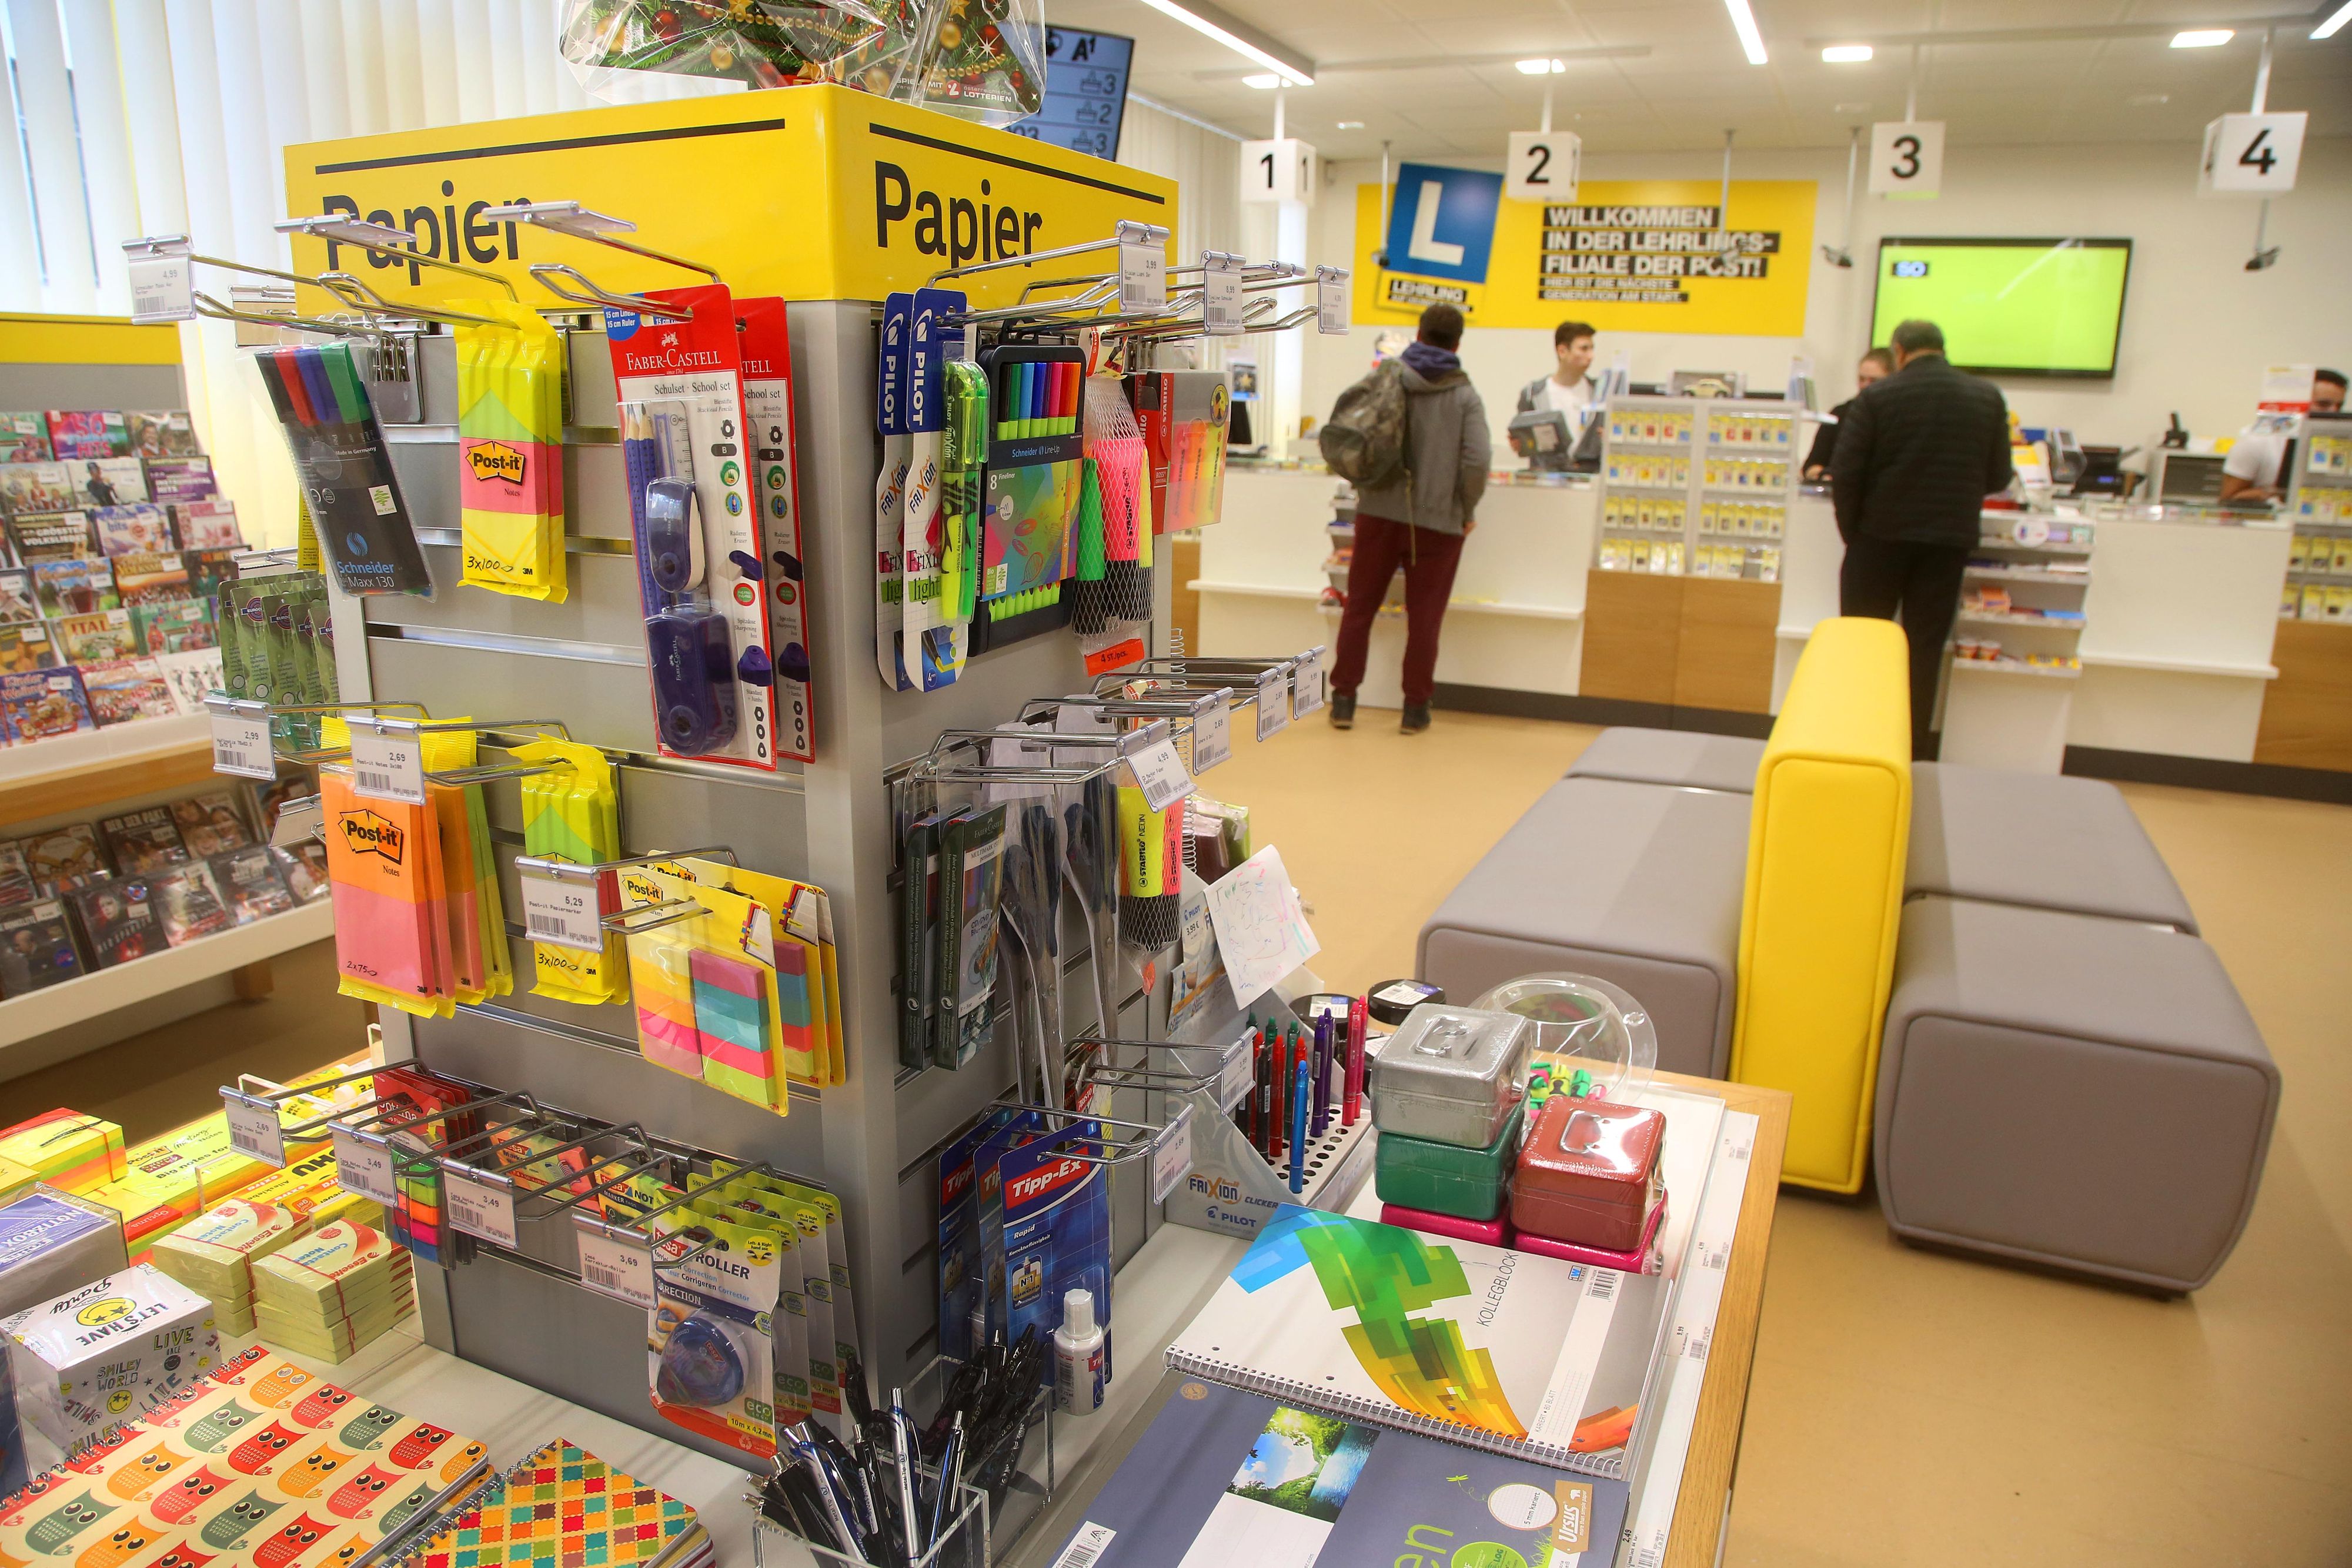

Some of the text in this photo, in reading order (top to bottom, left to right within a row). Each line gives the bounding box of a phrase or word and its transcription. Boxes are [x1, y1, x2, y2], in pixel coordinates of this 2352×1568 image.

[1103, 73, 1117, 95] 3
[964, 92, 1012, 102] LOTTERIEN
[1098, 103, 1112, 124] 2
[1095, 132, 1108, 153] 3
[1891, 135, 1922, 179] 3
[2239, 128, 2278, 176] 4
[1261, 153, 1275, 189] 1
[1526, 145, 1549, 184] 2
[875, 160, 1043, 278] Papier
[1408, 180, 1465, 266] L
[1548, 207, 1713, 227] WILLKOMMEN
[322, 180, 534, 286] Papier
[1547, 231, 1773, 253] IN DER LEHRLINGS-
[1146, 260, 1157, 269] 3,99
[1545, 255, 1762, 277] FILIALE DER POST!
[163, 270, 178, 279] 4,99
[1226, 285, 1235, 294] 8,99
[607, 320, 613, 329] 15
[622, 318, 636, 327] Ruler
[626, 349, 722, 371] FABER-CASTELL
[654, 381, 731, 394] Schulset School set
[743, 389, 781, 400] School set
[884, 355, 897, 429] PILOT
[913, 352, 926, 426] PILOT
[76, 441, 114, 459] HITS
[353, 445, 377, 455] Germany
[721, 446, 727, 454] B
[1011, 445, 1061, 458] Schneider Line-Up
[473, 452, 520, 470] Post-it
[990, 474, 997, 490] 8
[1155, 470, 1164, 479] BOSS
[504, 487, 520, 497] Notes
[336, 560, 394, 574] Schneider
[466, 556, 500, 571] 3x100
[522, 567, 533, 576] 3M
[348, 576, 395, 588] Maxx 130
[913, 576, 941, 605] light
[1101, 655, 1107, 663] 4
[245, 731, 259, 740] 2,99
[389, 753, 406, 762] 2,69
[1157, 751, 1170, 763] 4,99
[346, 820, 397, 847] Post-it
[383, 864, 400, 877] Notes
[627, 880, 660, 899] Post-it
[529, 901, 582, 915] Post-it Papiermarker
[565, 895, 583, 907] 5,29
[1188, 905, 1200, 918] PILOT
[971, 913, 989, 929] CD/DVD
[347, 961, 368, 974] 2x75
[537, 953, 567, 968] 3x100
[417, 985, 427, 994] 3M
[460, 977, 470, 986] 3M
[256, 1121, 269, 1132] 2,69
[1090, 1122, 1094, 1134] 1
[156, 1168, 179, 1179] Big
[179, 1153, 212, 1169] notes
[368, 1158, 382, 1169] 3,49
[246, 1175, 279, 1191] extra
[1012, 1158, 1082, 1199] Tipp-Ex
[483, 1195, 499, 1208] 3,49
[604, 1189, 624, 1203] MARKER
[1244, 1196, 1279, 1209] CLICKER
[130, 1209, 169, 1228] Optima
[1221, 1212, 1257, 1228] PILOT
[1, 1209, 83, 1247] NOTIZBOX
[206, 1218, 249, 1243] Contacta
[1013, 1224, 1035, 1240] Rapid
[236, 1229, 273, 1252] Esselte
[1008, 1233, 1051, 1257] Korrekturflüssigkeit
[303, 1242, 348, 1265] Contacta
[620, 1255, 638, 1266] 3,69
[329, 1256, 368, 1279] Esselte
[683, 1265, 718, 1283] Correction
[693, 1253, 751, 1280] ROLLER
[49, 1276, 112, 1315] Party
[681, 1273, 750, 1303] Corrigeren Corrector
[1476, 1251, 1520, 1328] KOLLEGBLOCK
[76, 1302, 170, 1347] LET'S HAVE
[153, 1326, 195, 1351] LIVE
[97, 1358, 142, 1379] SMILEY
[97, 1372, 139, 1393] WORLD
[746, 1400, 771, 1417] eco
[1535, 1413, 1546, 1433] KARIERT
[1546, 1389, 1557, 1403] BLATT
[731, 1418, 745, 1429] 10m
[752, 1427, 773, 1440] 4,2mm
[1526, 1509, 1535, 1520] mm
[1531, 1492, 1541, 1509] kariert
[830, 1508, 839, 1522] Metal
[1558, 1504, 1580, 1543] Ursus
[1621, 1529, 1632, 1543] 2,49
